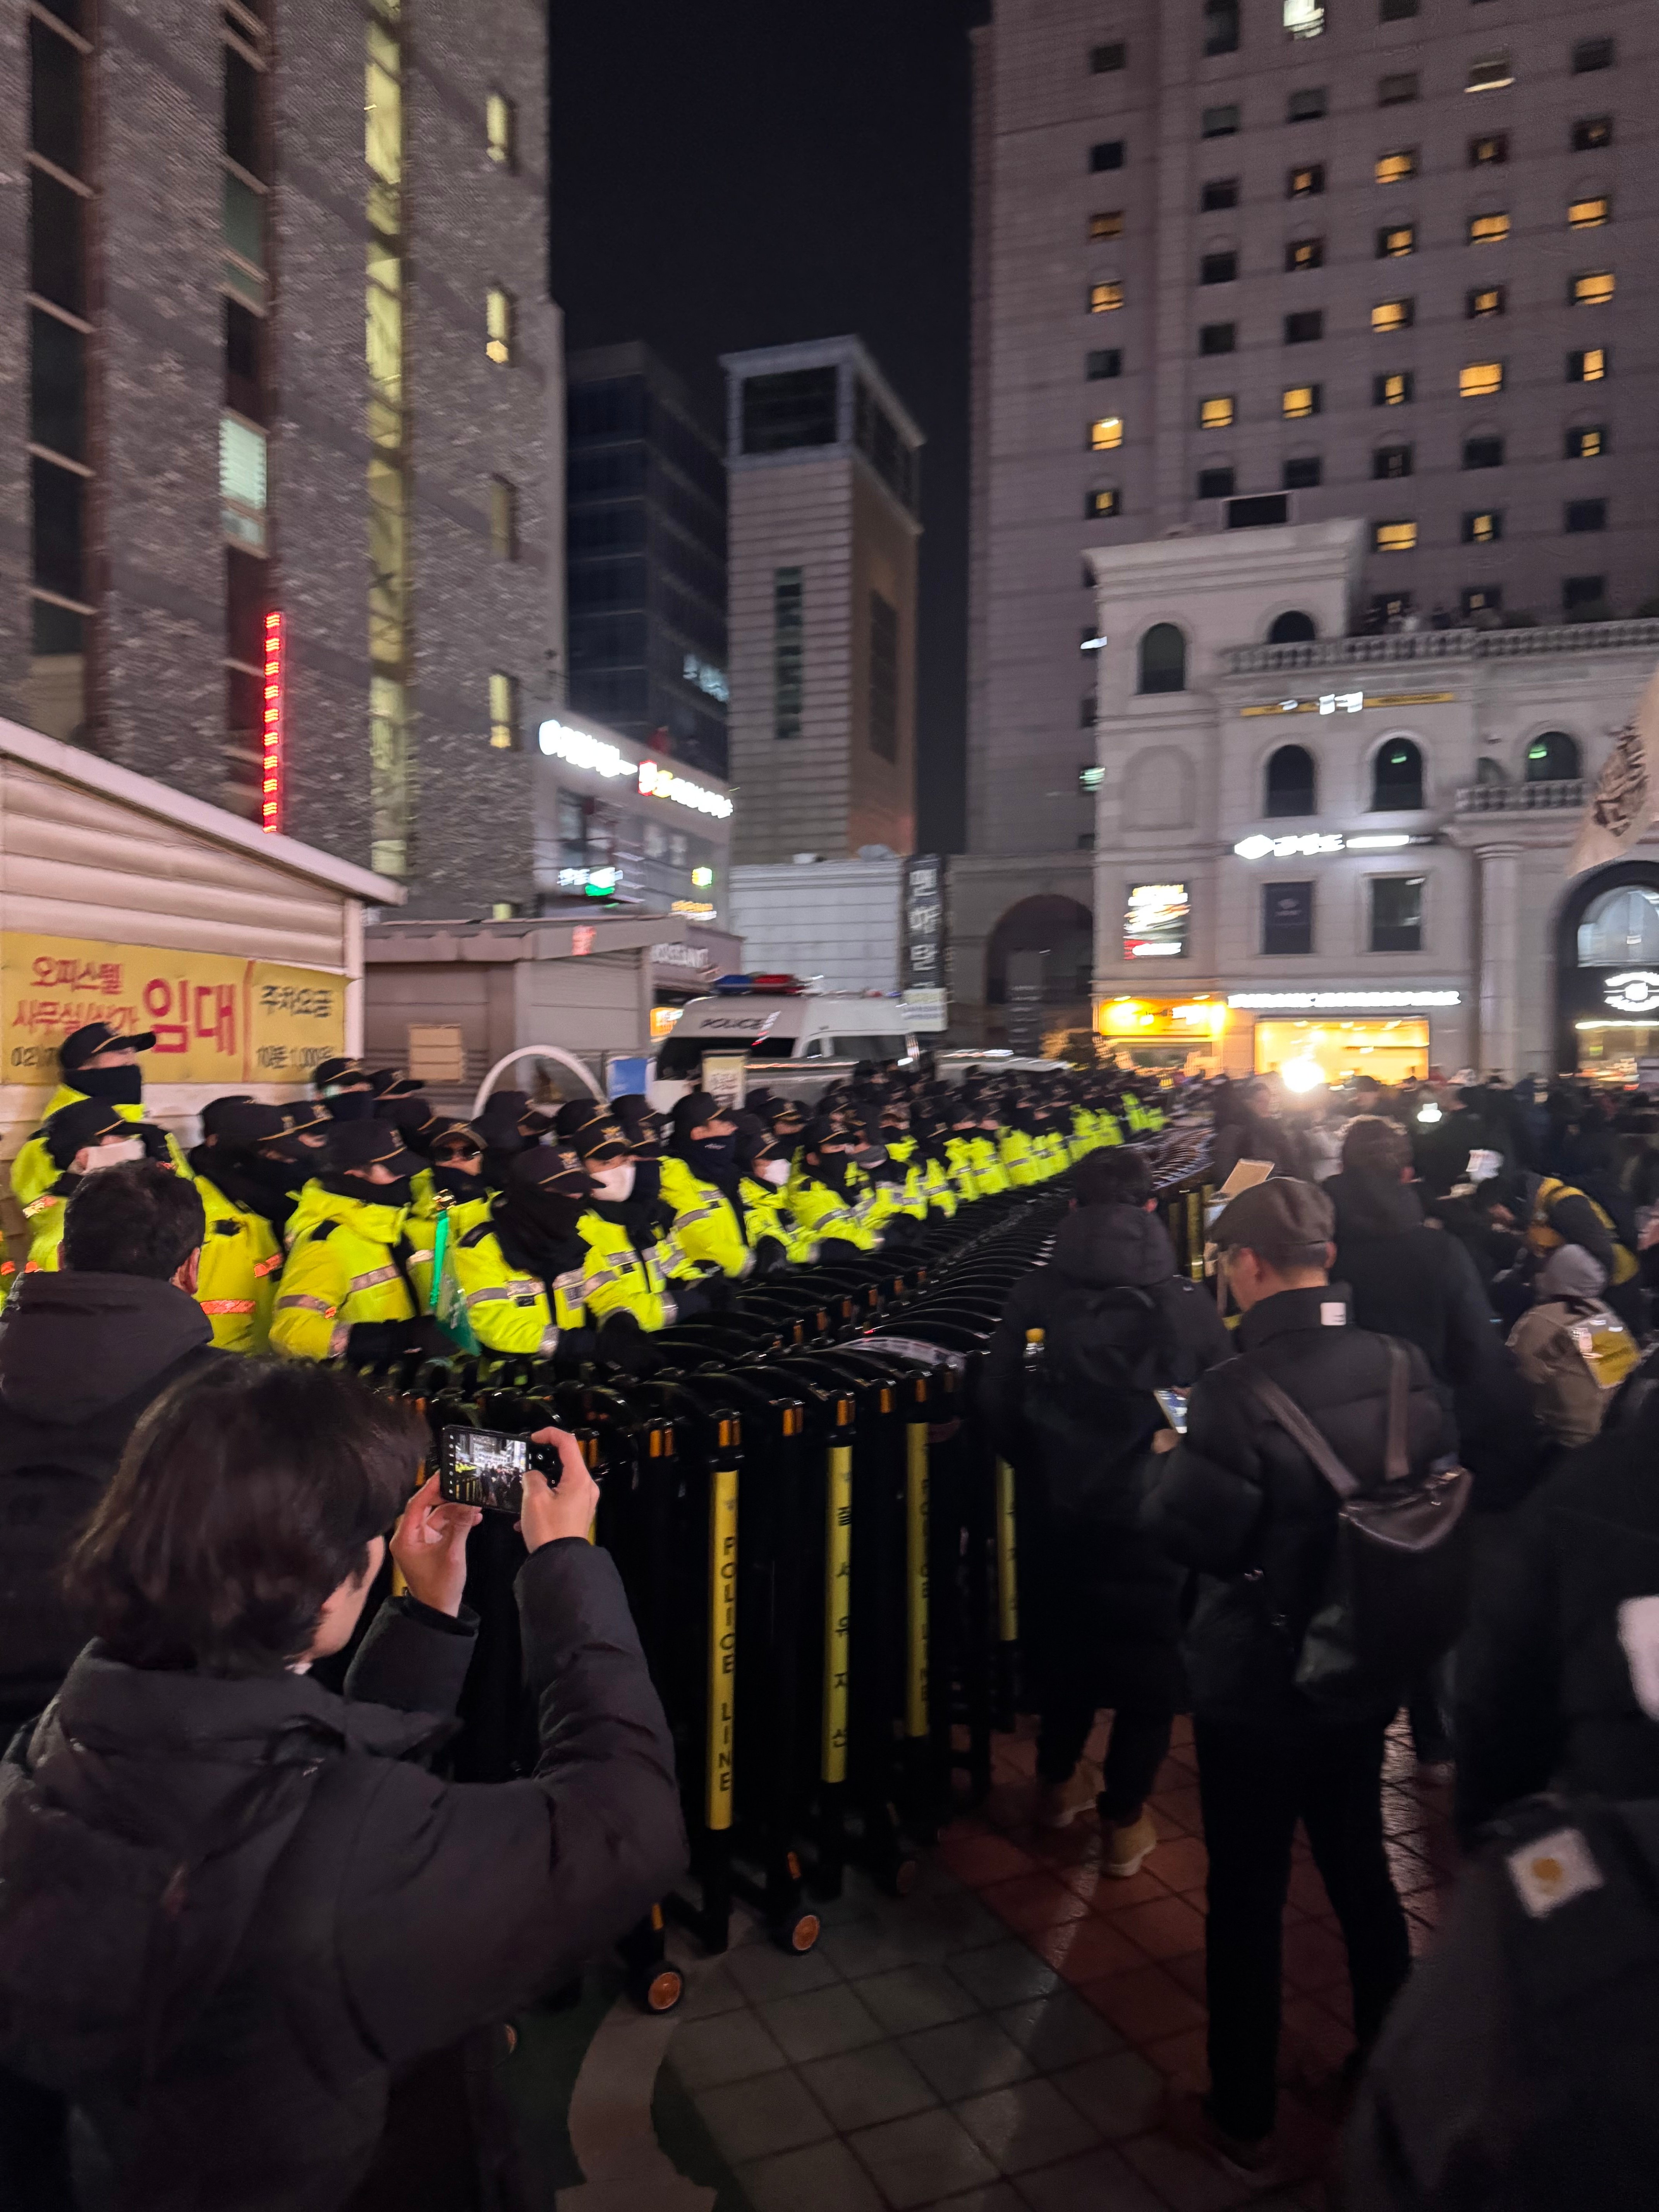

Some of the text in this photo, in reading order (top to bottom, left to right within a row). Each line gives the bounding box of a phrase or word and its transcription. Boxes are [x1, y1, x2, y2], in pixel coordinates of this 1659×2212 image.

[31, 956, 122, 994] 오피스텔
[143, 978, 237, 1056] 임대
[718, 1537, 735, 1791] POLICE LINE
